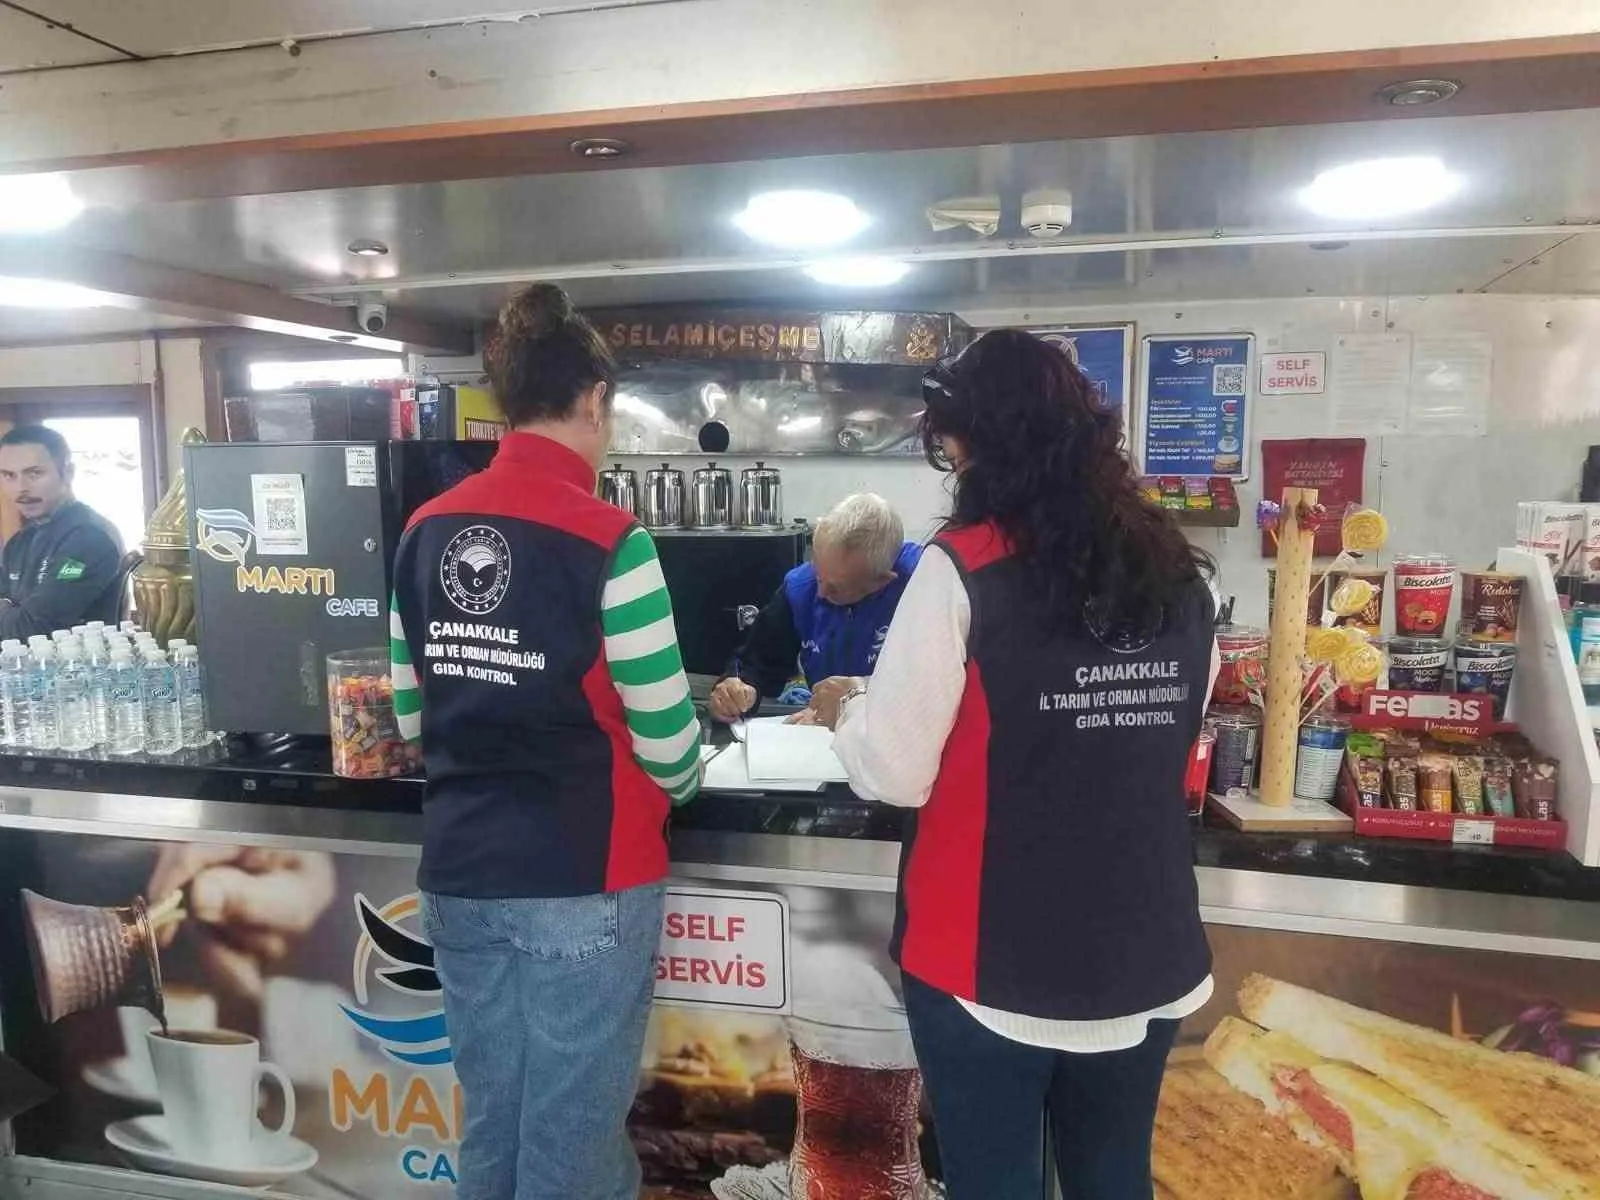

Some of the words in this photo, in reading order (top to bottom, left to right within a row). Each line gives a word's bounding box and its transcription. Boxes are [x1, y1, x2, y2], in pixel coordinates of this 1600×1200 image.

[1276, 359, 1310, 371] SELF
[1267, 374, 1317, 388] SERVİS
[236, 565, 335, 595] MARTI
[326, 598, 379, 617] CAFE
[429, 621, 519, 645] ÇANAKKALE
[446, 644, 460, 658] VE
[462, 645, 489, 662] ORMAN
[490, 648, 546, 671] MÜDÜRLÜĞÜ
[433, 663, 464, 677] GIDA
[467, 666, 518, 686] KONTROL
[1075, 661, 1180, 687] ÇANAKKALE
[1039, 692, 1051, 711] İL
[1053, 693, 1090, 709] TARIM
[1092, 691, 1107, 708] VE
[1108, 688, 1147, 706] ORMAN
[1369, 694, 1481, 721] Feas
[1076, 715, 1110, 729] GIDA
[1114, 711, 1176, 727] KONTROL
[665, 912, 746, 942] SELF
[656, 953, 767, 988] SERVİS
